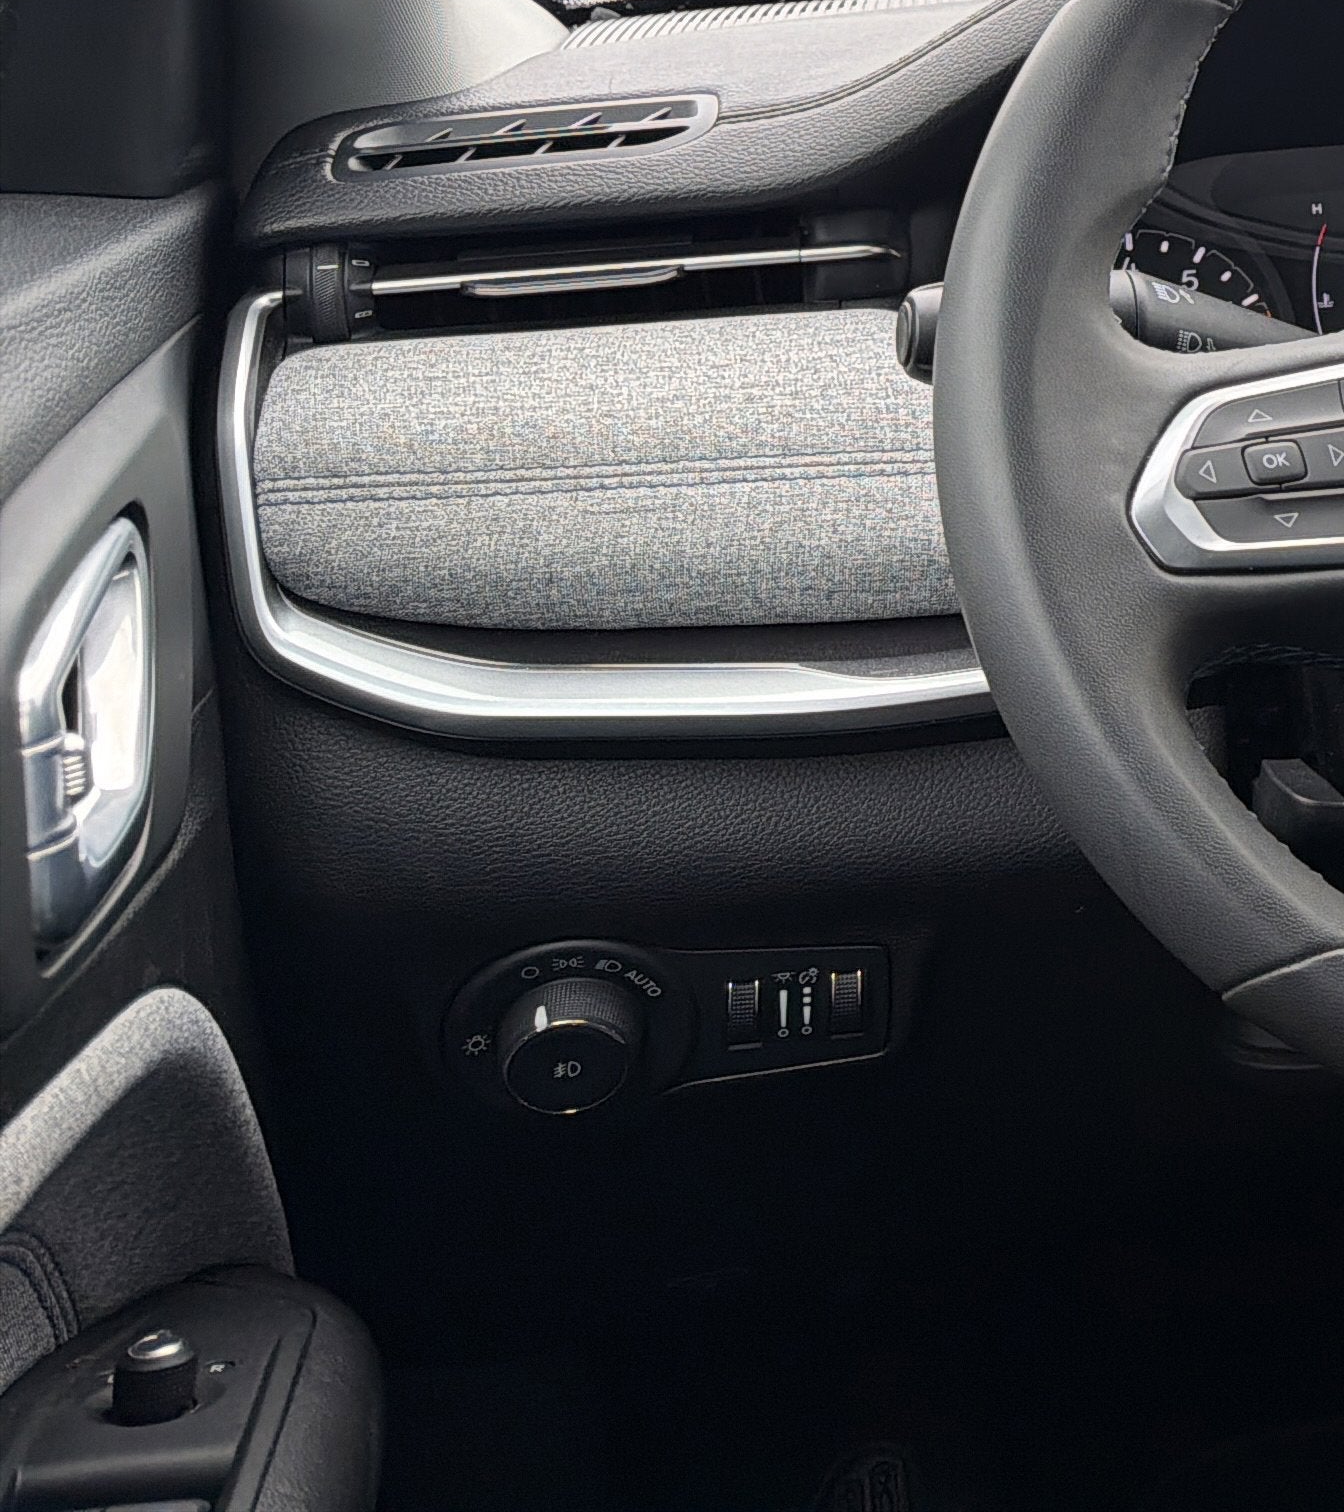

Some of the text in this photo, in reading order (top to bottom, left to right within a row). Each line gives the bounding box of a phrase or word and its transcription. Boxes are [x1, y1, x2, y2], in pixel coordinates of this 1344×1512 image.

[1311, 203, 1323, 215] H
[1181, 269, 1199, 291] 5
[1262, 452, 1291, 469] OK
[625, 968, 662, 998] AUTO
